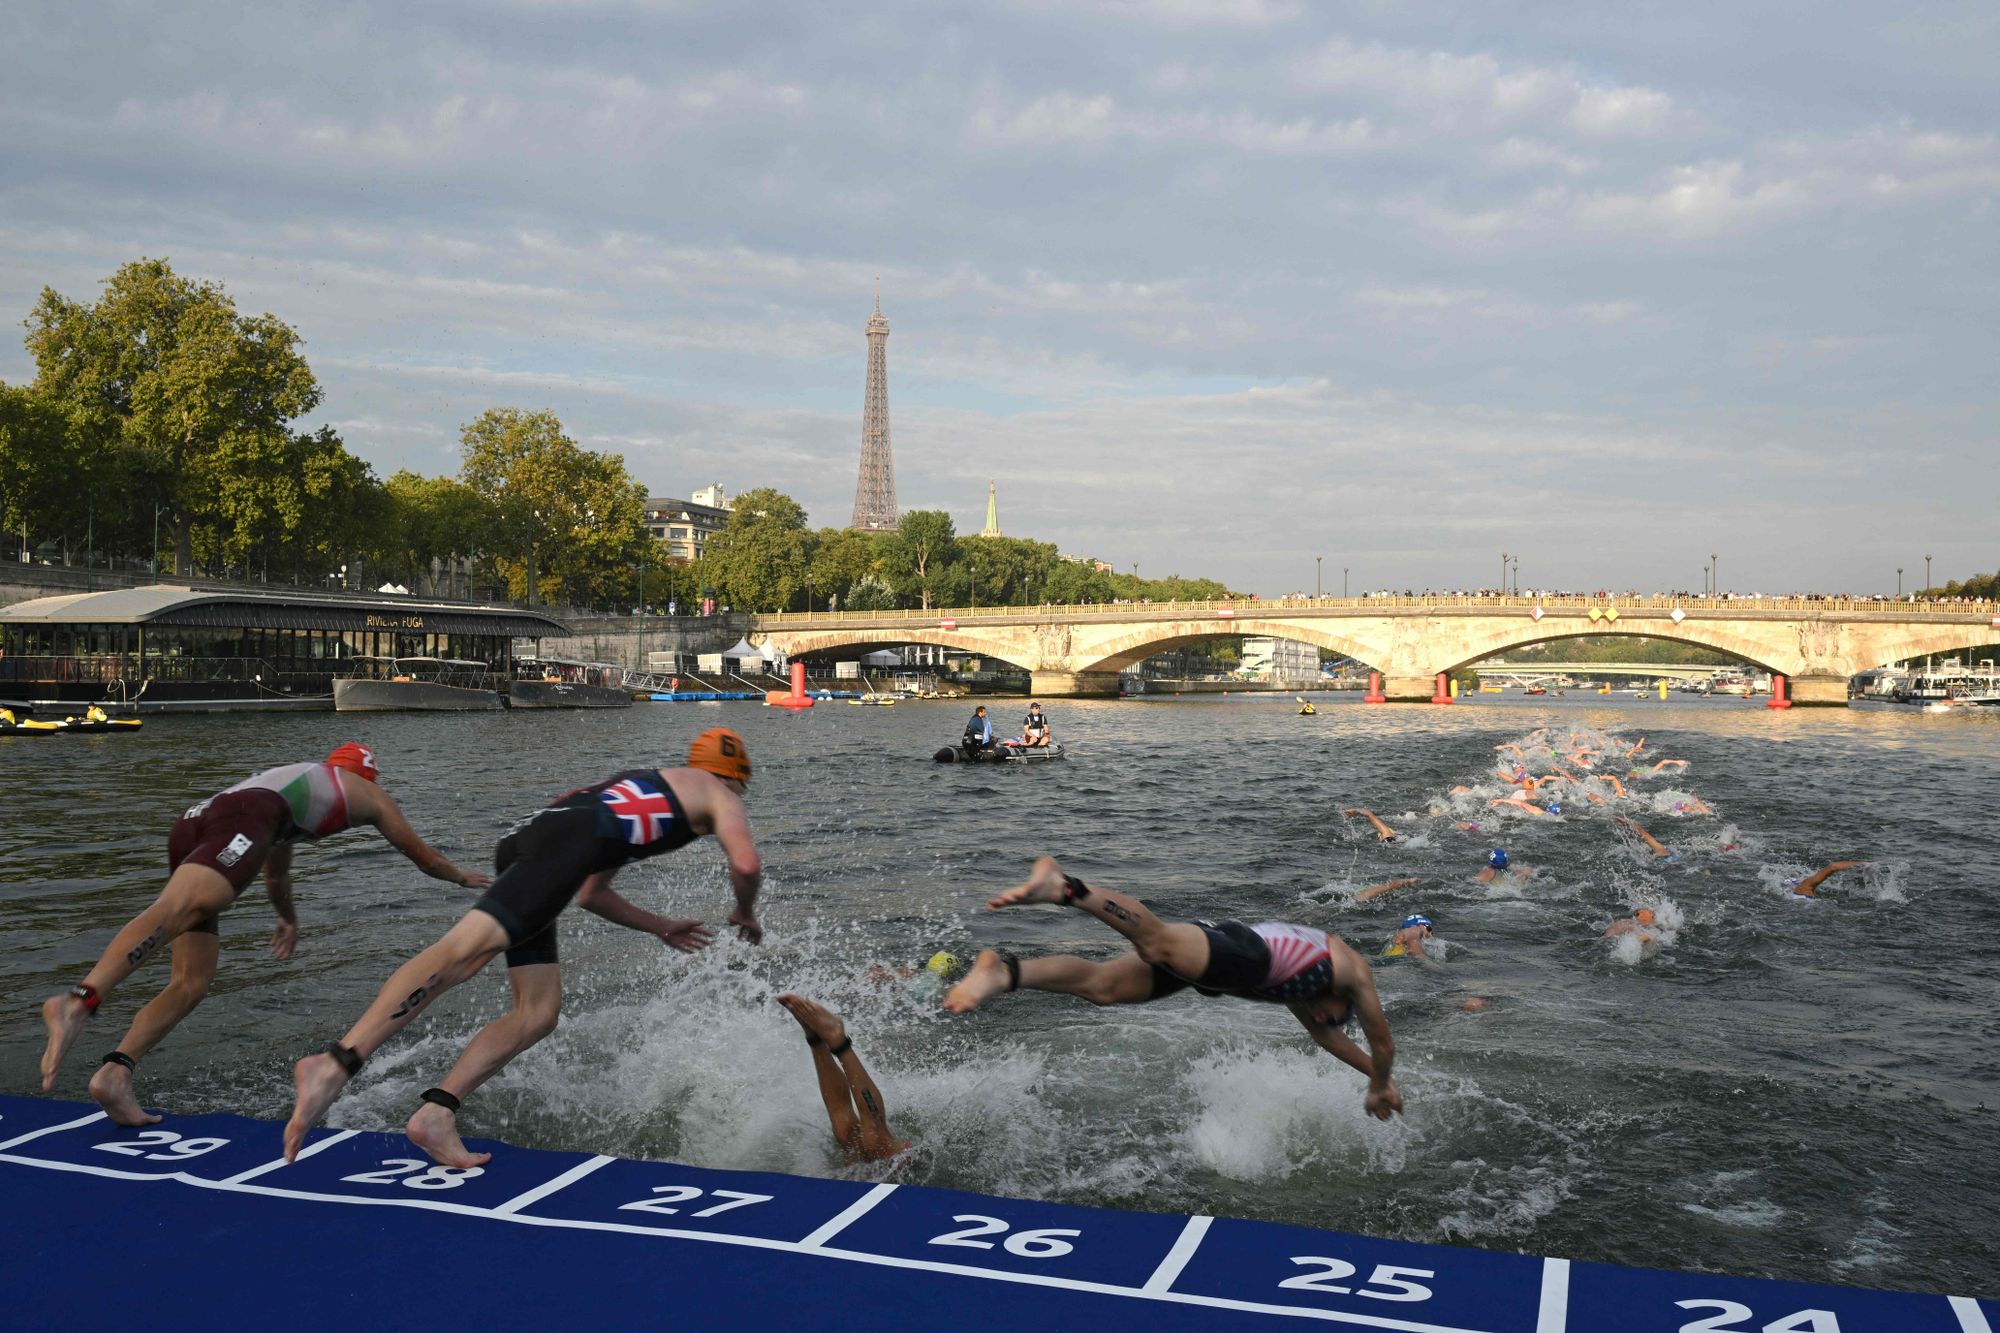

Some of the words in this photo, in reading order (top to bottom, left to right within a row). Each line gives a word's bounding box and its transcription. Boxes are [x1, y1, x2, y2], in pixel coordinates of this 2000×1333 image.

[402, 616, 424, 628] FUGA
[91, 1131, 231, 1160] 29
[339, 1158, 485, 1189] 28
[618, 1185, 773, 1216] 27
[927, 1214, 1082, 1257] 26
[1278, 1256, 1435, 1302] 25
[1673, 1299, 1841, 1333] 24
